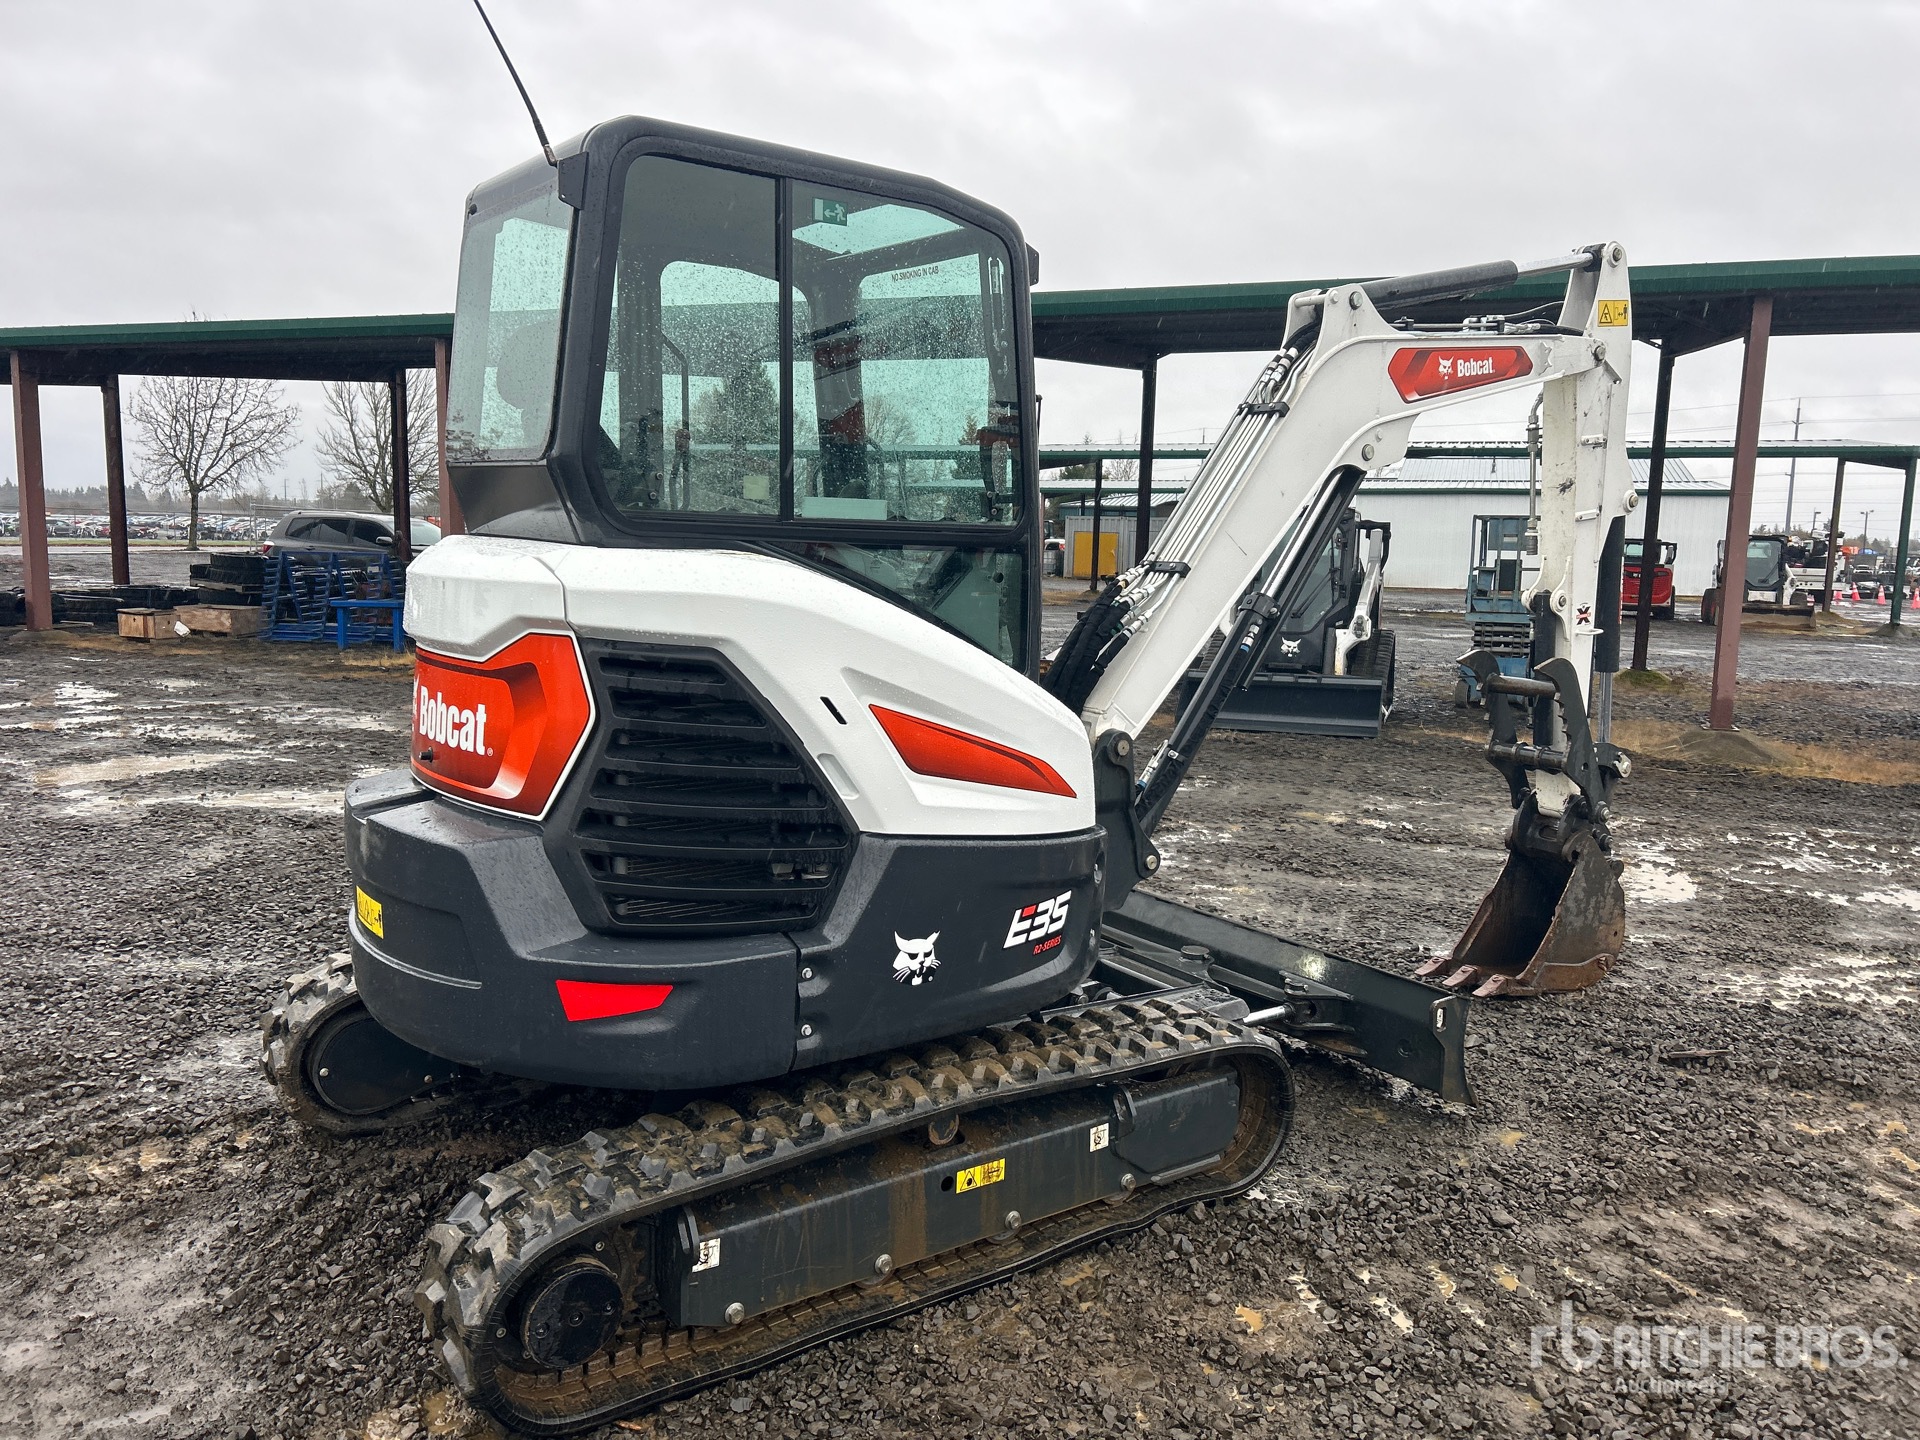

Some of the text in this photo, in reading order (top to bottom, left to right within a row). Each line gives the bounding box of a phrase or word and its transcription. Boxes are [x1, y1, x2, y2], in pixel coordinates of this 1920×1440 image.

[928, 265, 940, 275] CAB
[1457, 357, 1493, 377] Bobcat
[420, 685, 487, 756] Bobcat
[1003, 890, 1072, 949] E35
[1033, 935, 1062, 955] R2-SERIES
